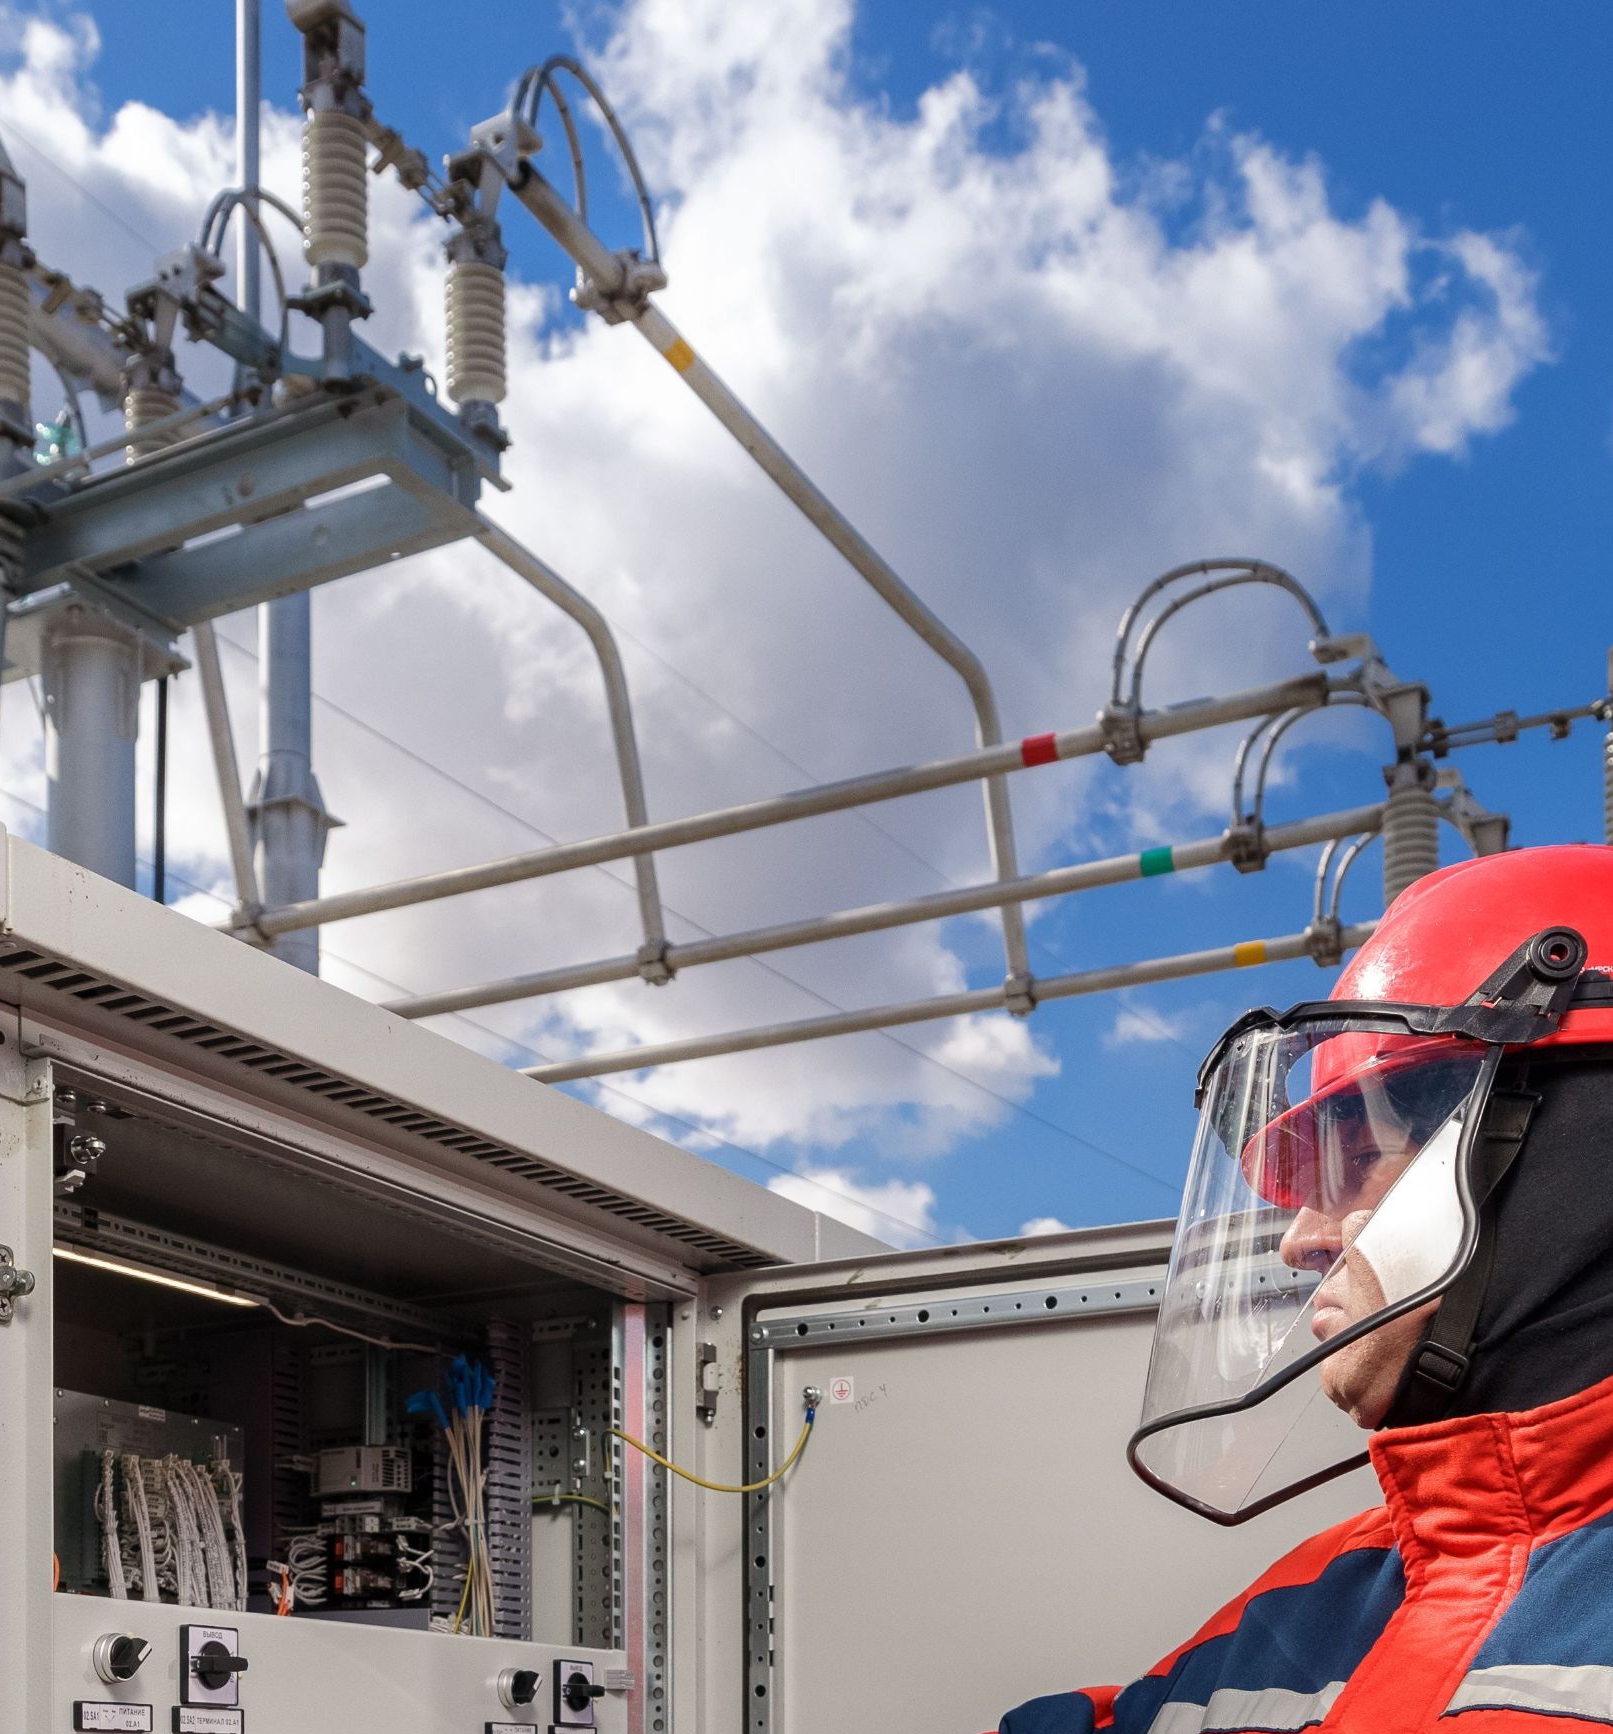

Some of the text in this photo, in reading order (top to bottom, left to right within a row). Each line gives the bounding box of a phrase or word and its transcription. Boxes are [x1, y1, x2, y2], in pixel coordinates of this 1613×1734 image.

[203, 1630, 223, 1640] ВЫВОД
[118, 1708, 146, 1717] ПИТАНИЕ
[196, 1716, 225, 1726] ТЕРМИНАЛ
